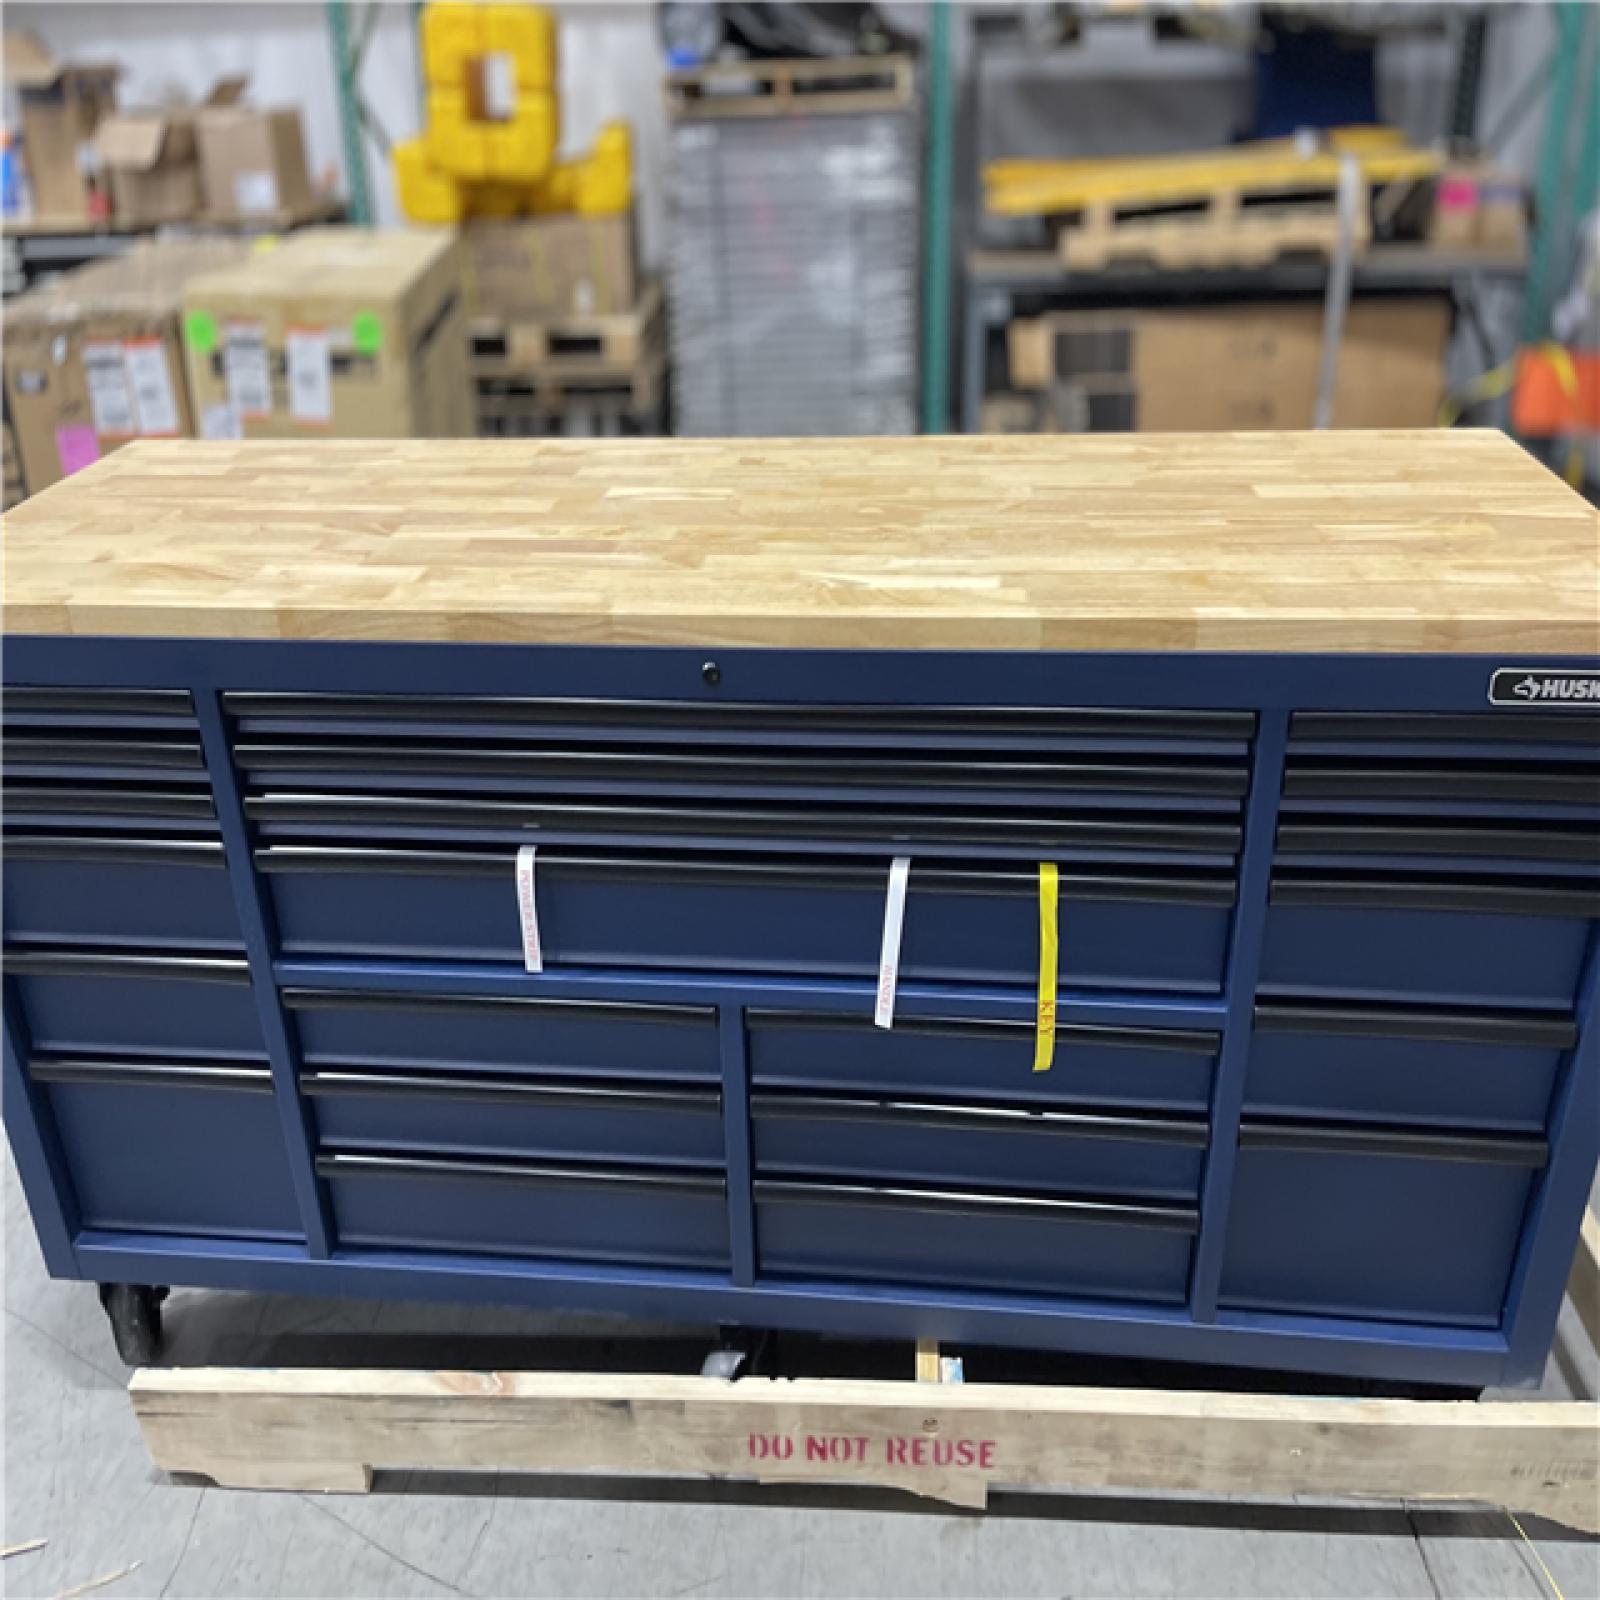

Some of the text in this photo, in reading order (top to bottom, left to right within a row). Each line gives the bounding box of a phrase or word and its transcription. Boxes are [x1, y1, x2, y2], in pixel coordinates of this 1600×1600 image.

[1039, 1000, 1055, 1034] KEY
[748, 1433, 996, 1469] DO NOT REUSE
